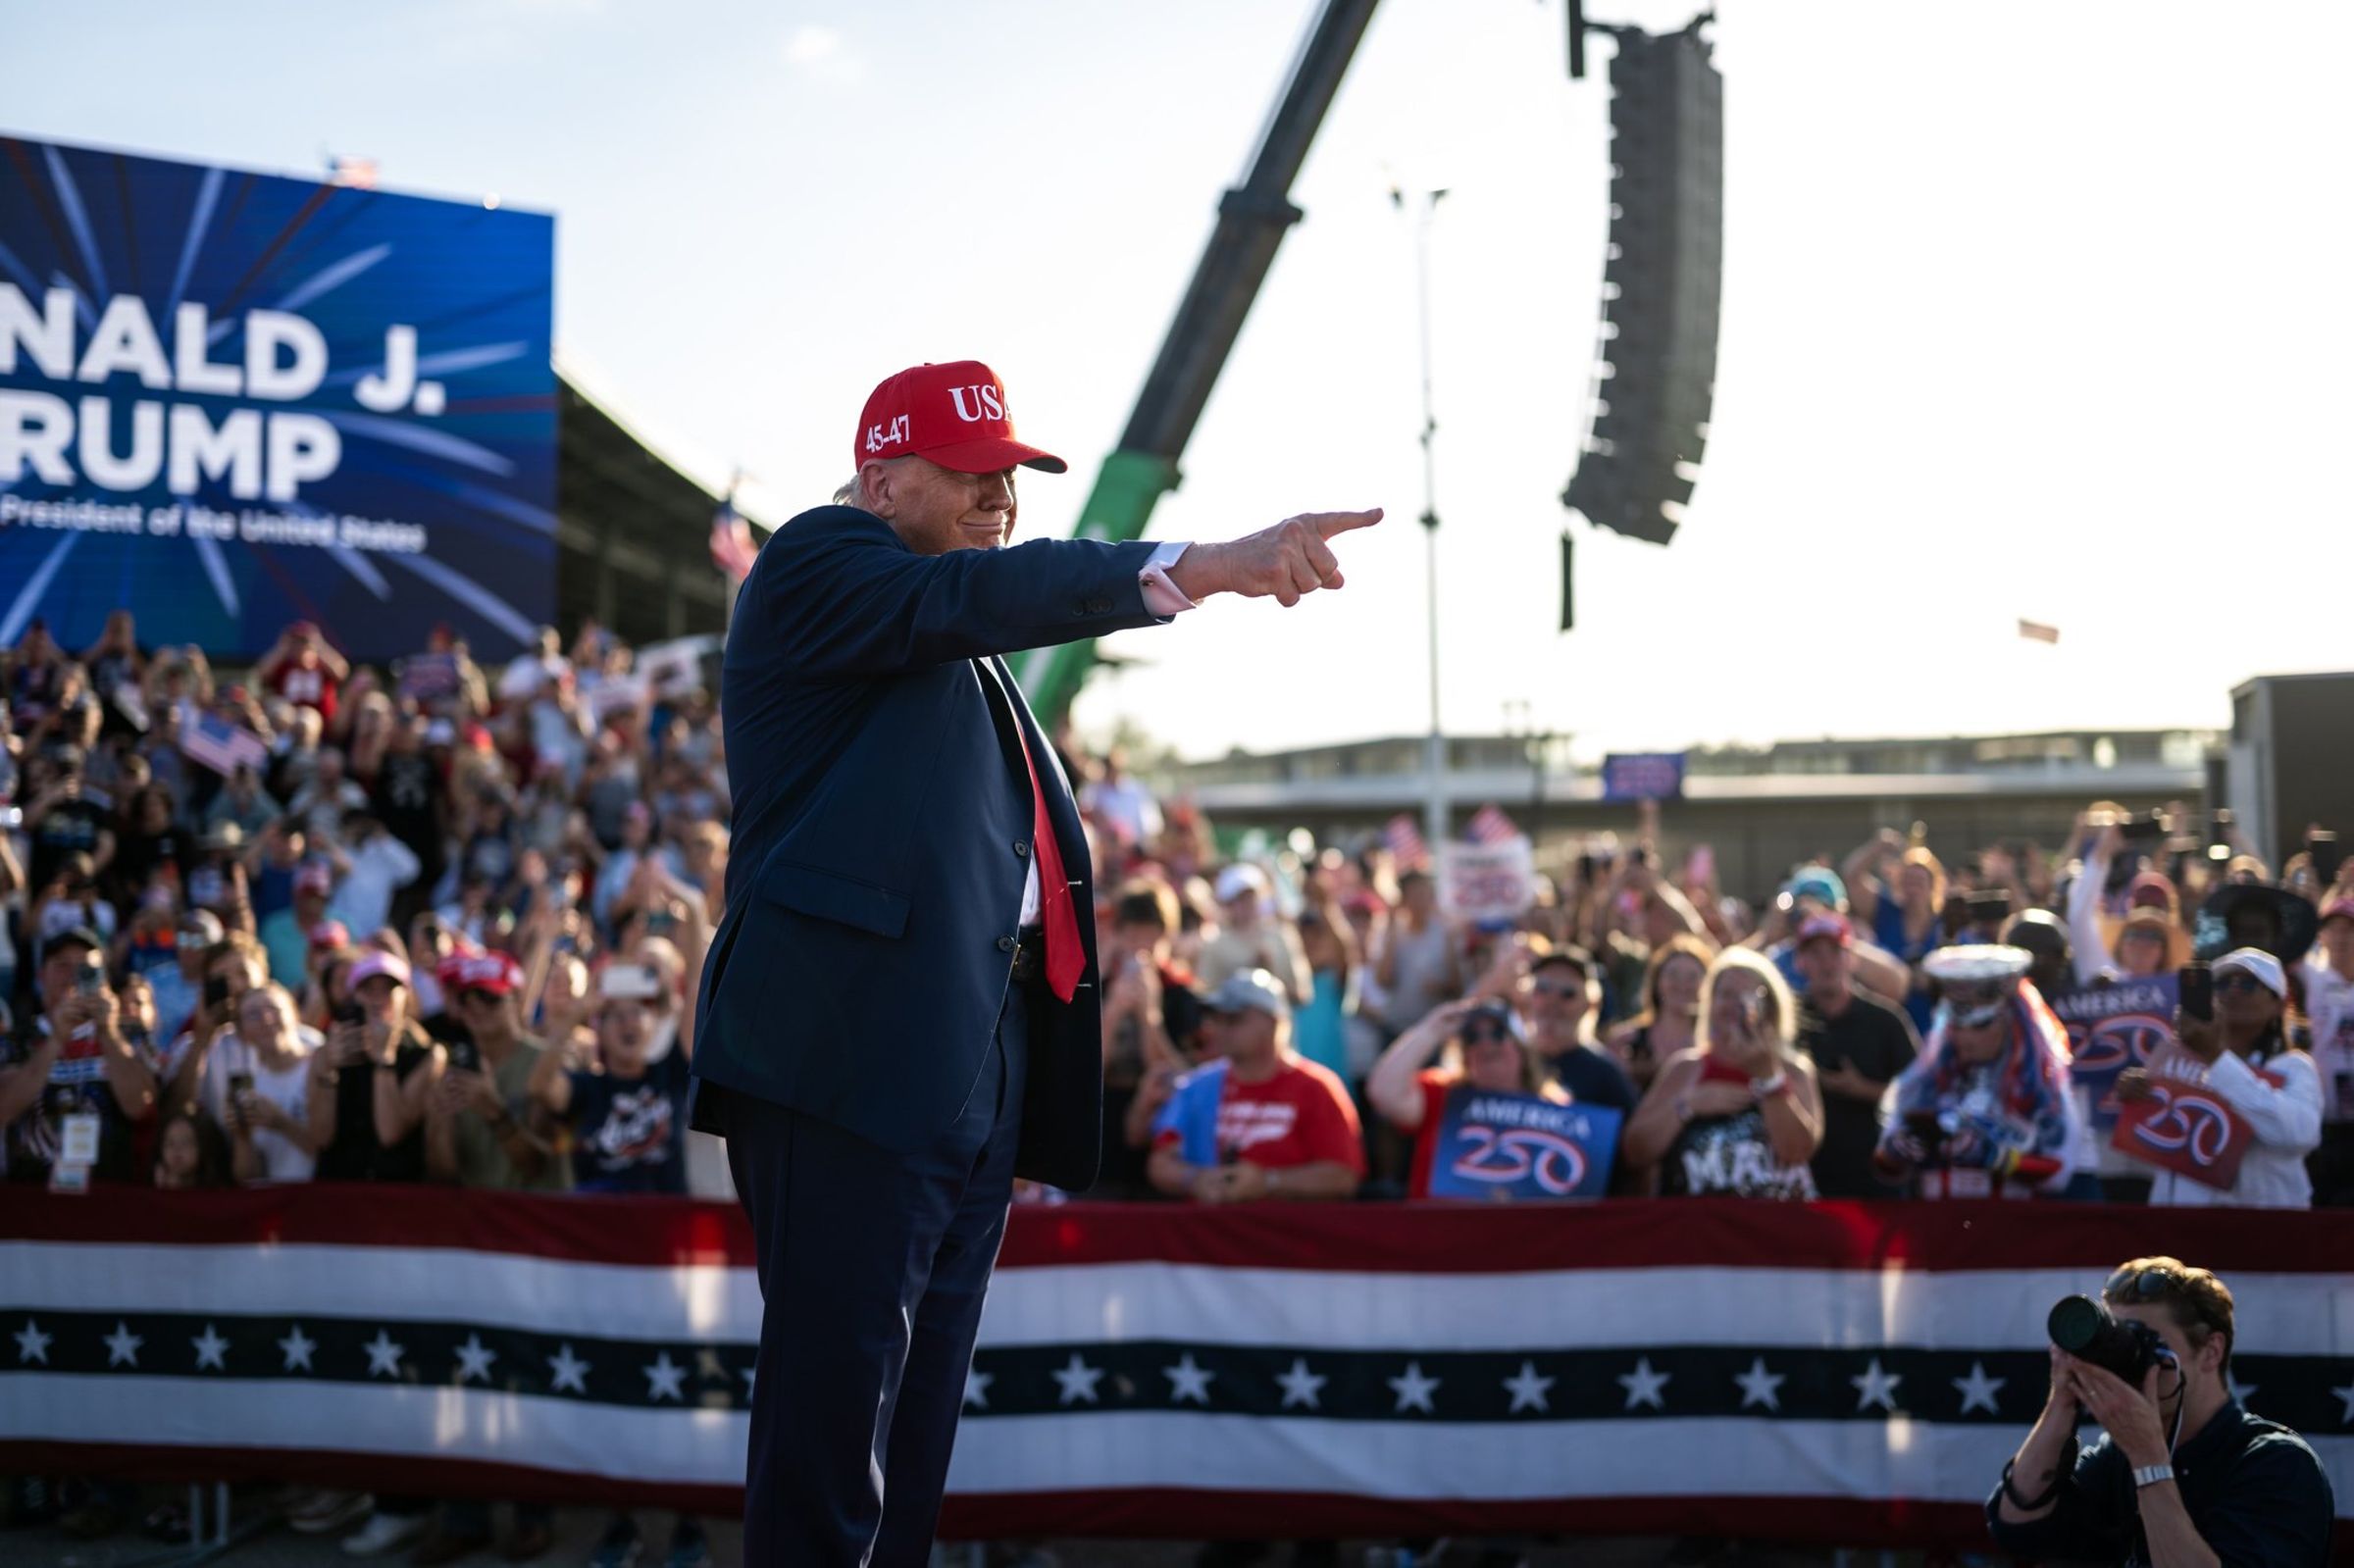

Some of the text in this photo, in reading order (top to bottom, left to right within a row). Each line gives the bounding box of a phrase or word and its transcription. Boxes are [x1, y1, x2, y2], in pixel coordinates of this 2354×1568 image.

[0, 280, 446, 416] NALD J.
[0, 388, 342, 502] RUMP
[865, 414, 911, 453] 45-47
[0, 493, 427, 554] President of the United States
[1461, 1097, 1592, 1141] AMERICA
[2132, 1086, 2231, 1168] 250
[1452, 1125, 1587, 1195] 250
